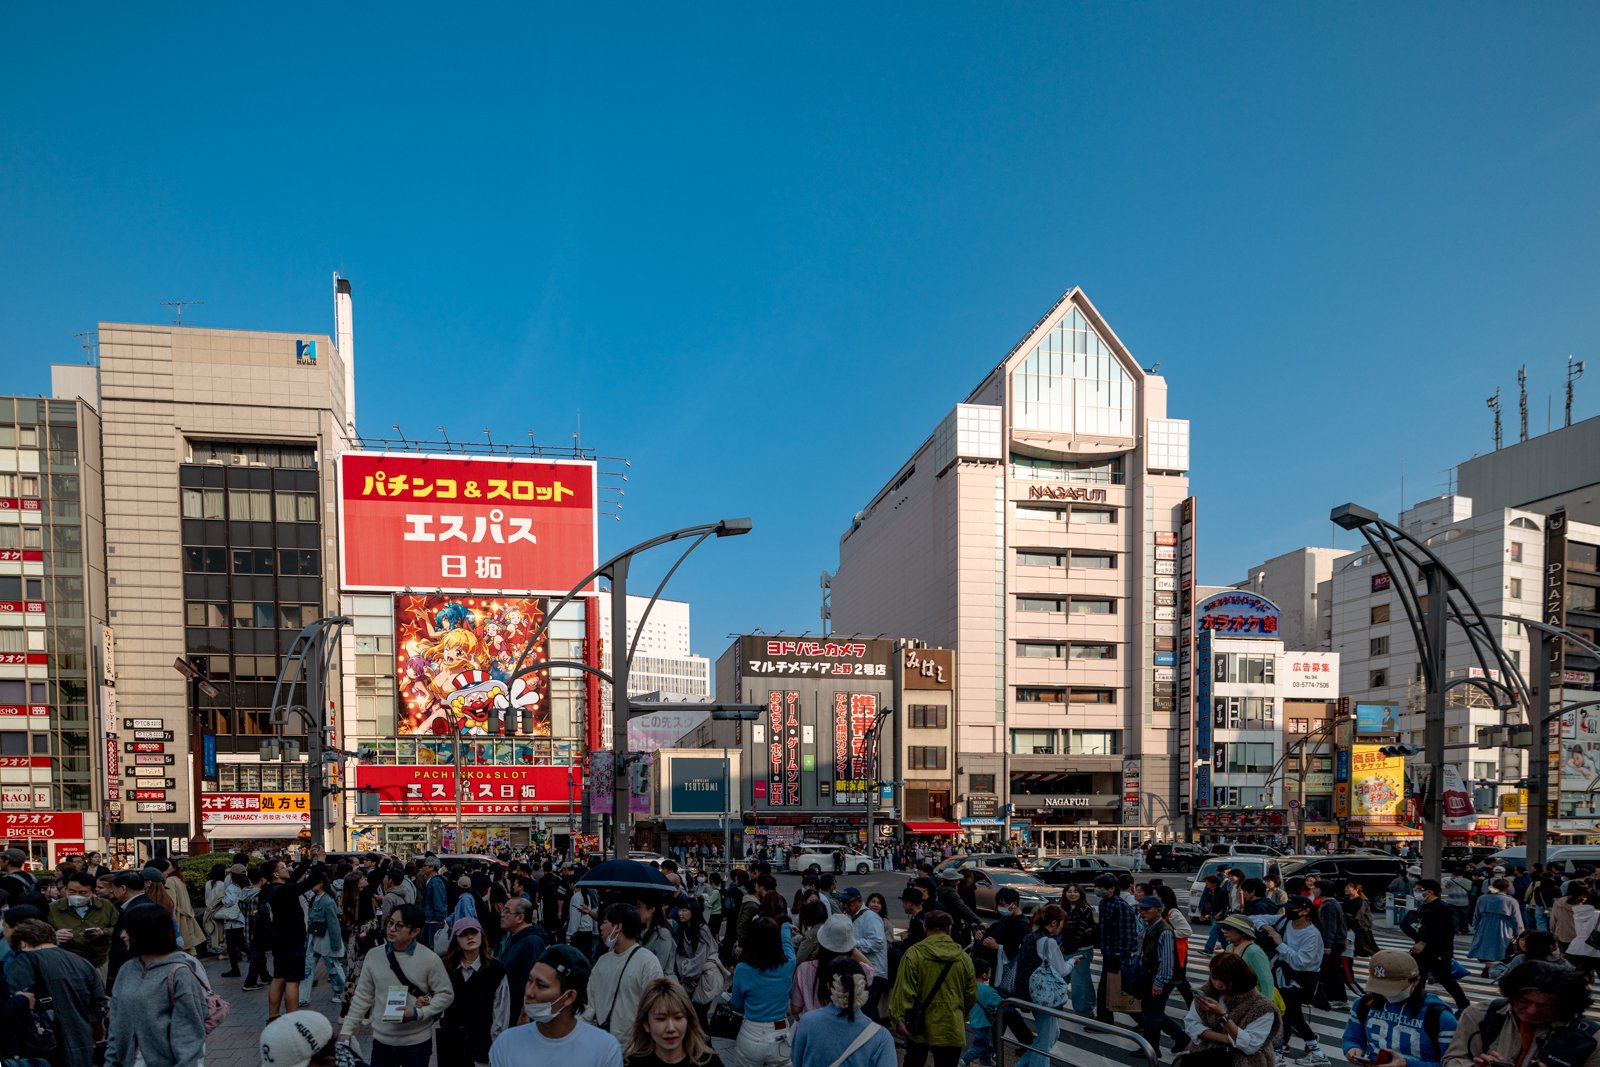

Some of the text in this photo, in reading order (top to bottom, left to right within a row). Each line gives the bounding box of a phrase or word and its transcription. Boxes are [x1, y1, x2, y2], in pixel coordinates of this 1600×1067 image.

[404, 508, 537, 544] エスパス
[441, 555, 502, 579] 日拓
[1549, 563, 1562, 626] PLAZA
[1203, 614, 1278, 631] カラオケ館
[768, 641, 866, 657] ヨドバシカメラ
[1292, 662, 1330, 672] 広告募集
[770, 692, 783, 805] おもちゃ・ホビー・玩具
[787, 692, 799, 804] ゲーム・ゲームソフト
[684, 782, 718, 791] TSUTSUMI
[202, 796, 260, 808] スギ薬局
[1045, 798, 1090, 806] NAGAFUJI
[6, 814, 54, 824] カラオケ
[6, 828, 54, 836] BIG ECHO
[1368, 1009, 1424, 1028] FRANKLIN
[1366, 1018, 1421, 1058] 30
